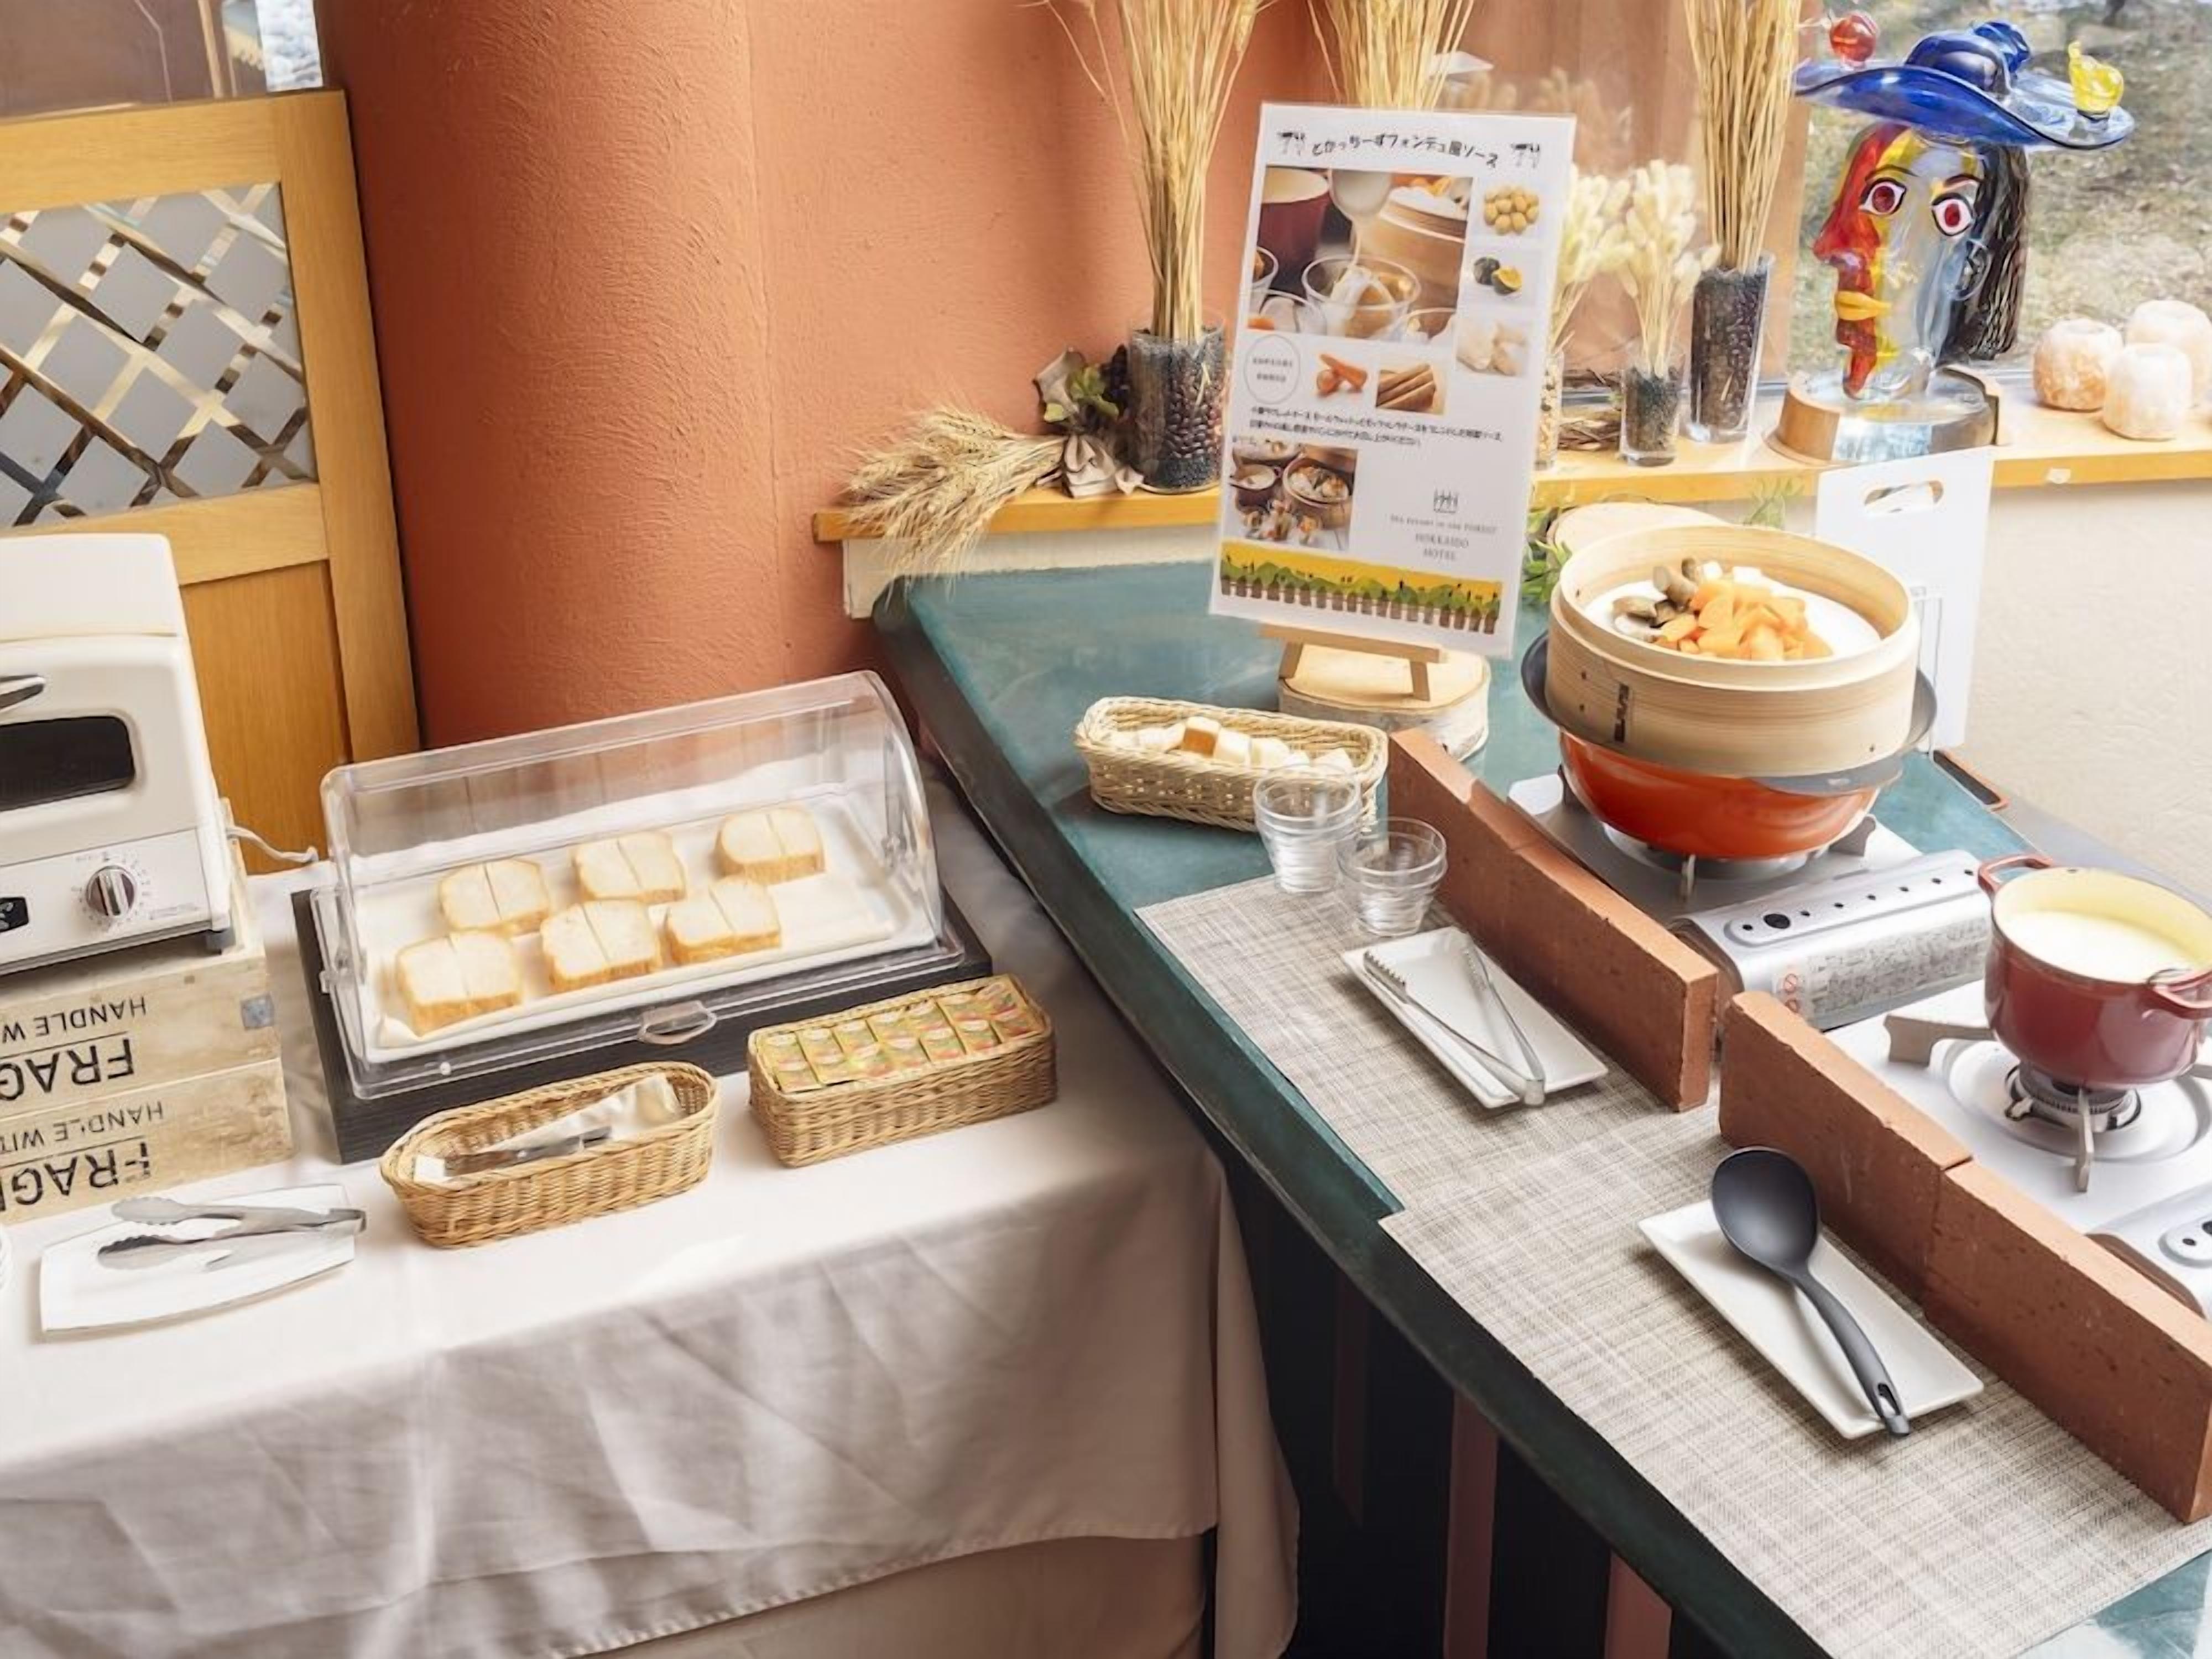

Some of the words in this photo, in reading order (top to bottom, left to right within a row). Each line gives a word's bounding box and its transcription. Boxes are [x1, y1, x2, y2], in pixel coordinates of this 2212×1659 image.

[33, 996, 146, 1037] HANDLE
[0, 1038, 134, 1101] FRAG
[53, 1101, 164, 1142] HANDLE
